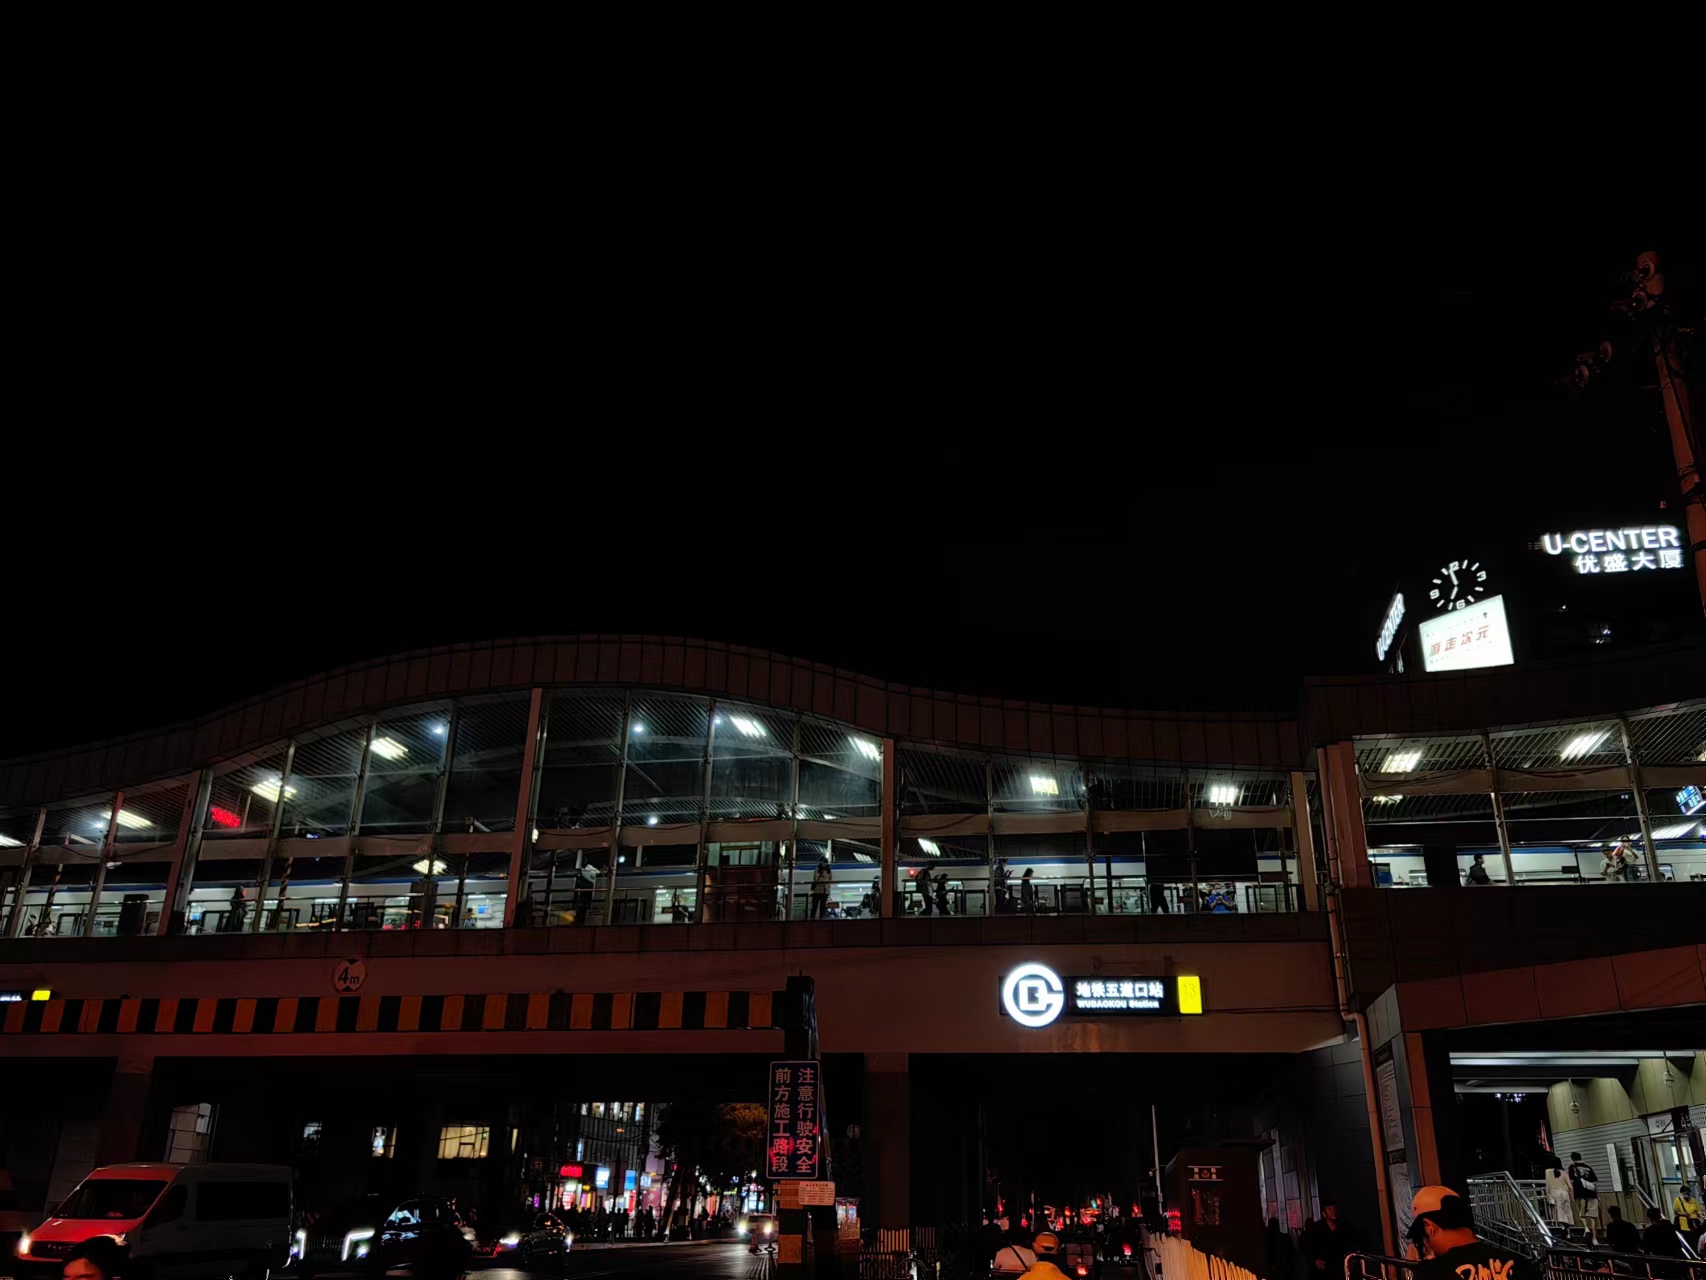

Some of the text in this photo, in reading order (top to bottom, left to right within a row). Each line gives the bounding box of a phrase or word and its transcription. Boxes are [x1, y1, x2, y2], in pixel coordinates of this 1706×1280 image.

[1543, 525, 1681, 556] U-CENTER
[1575, 550, 1684, 574] 优盛大厦
[1476, 570, 1487, 582] 3
[1429, 588, 1440, 600] 9
[1456, 599, 1466, 610] 6
[338, 966, 360, 984] 4m
[1076, 982, 1164, 998] 地铁五道口站
[1076, 999, 1127, 1009] WUDAOKOU
[771, 1068, 792, 1173] 前方施工路段
[796, 1068, 815, 1173] 注意行驶安全
